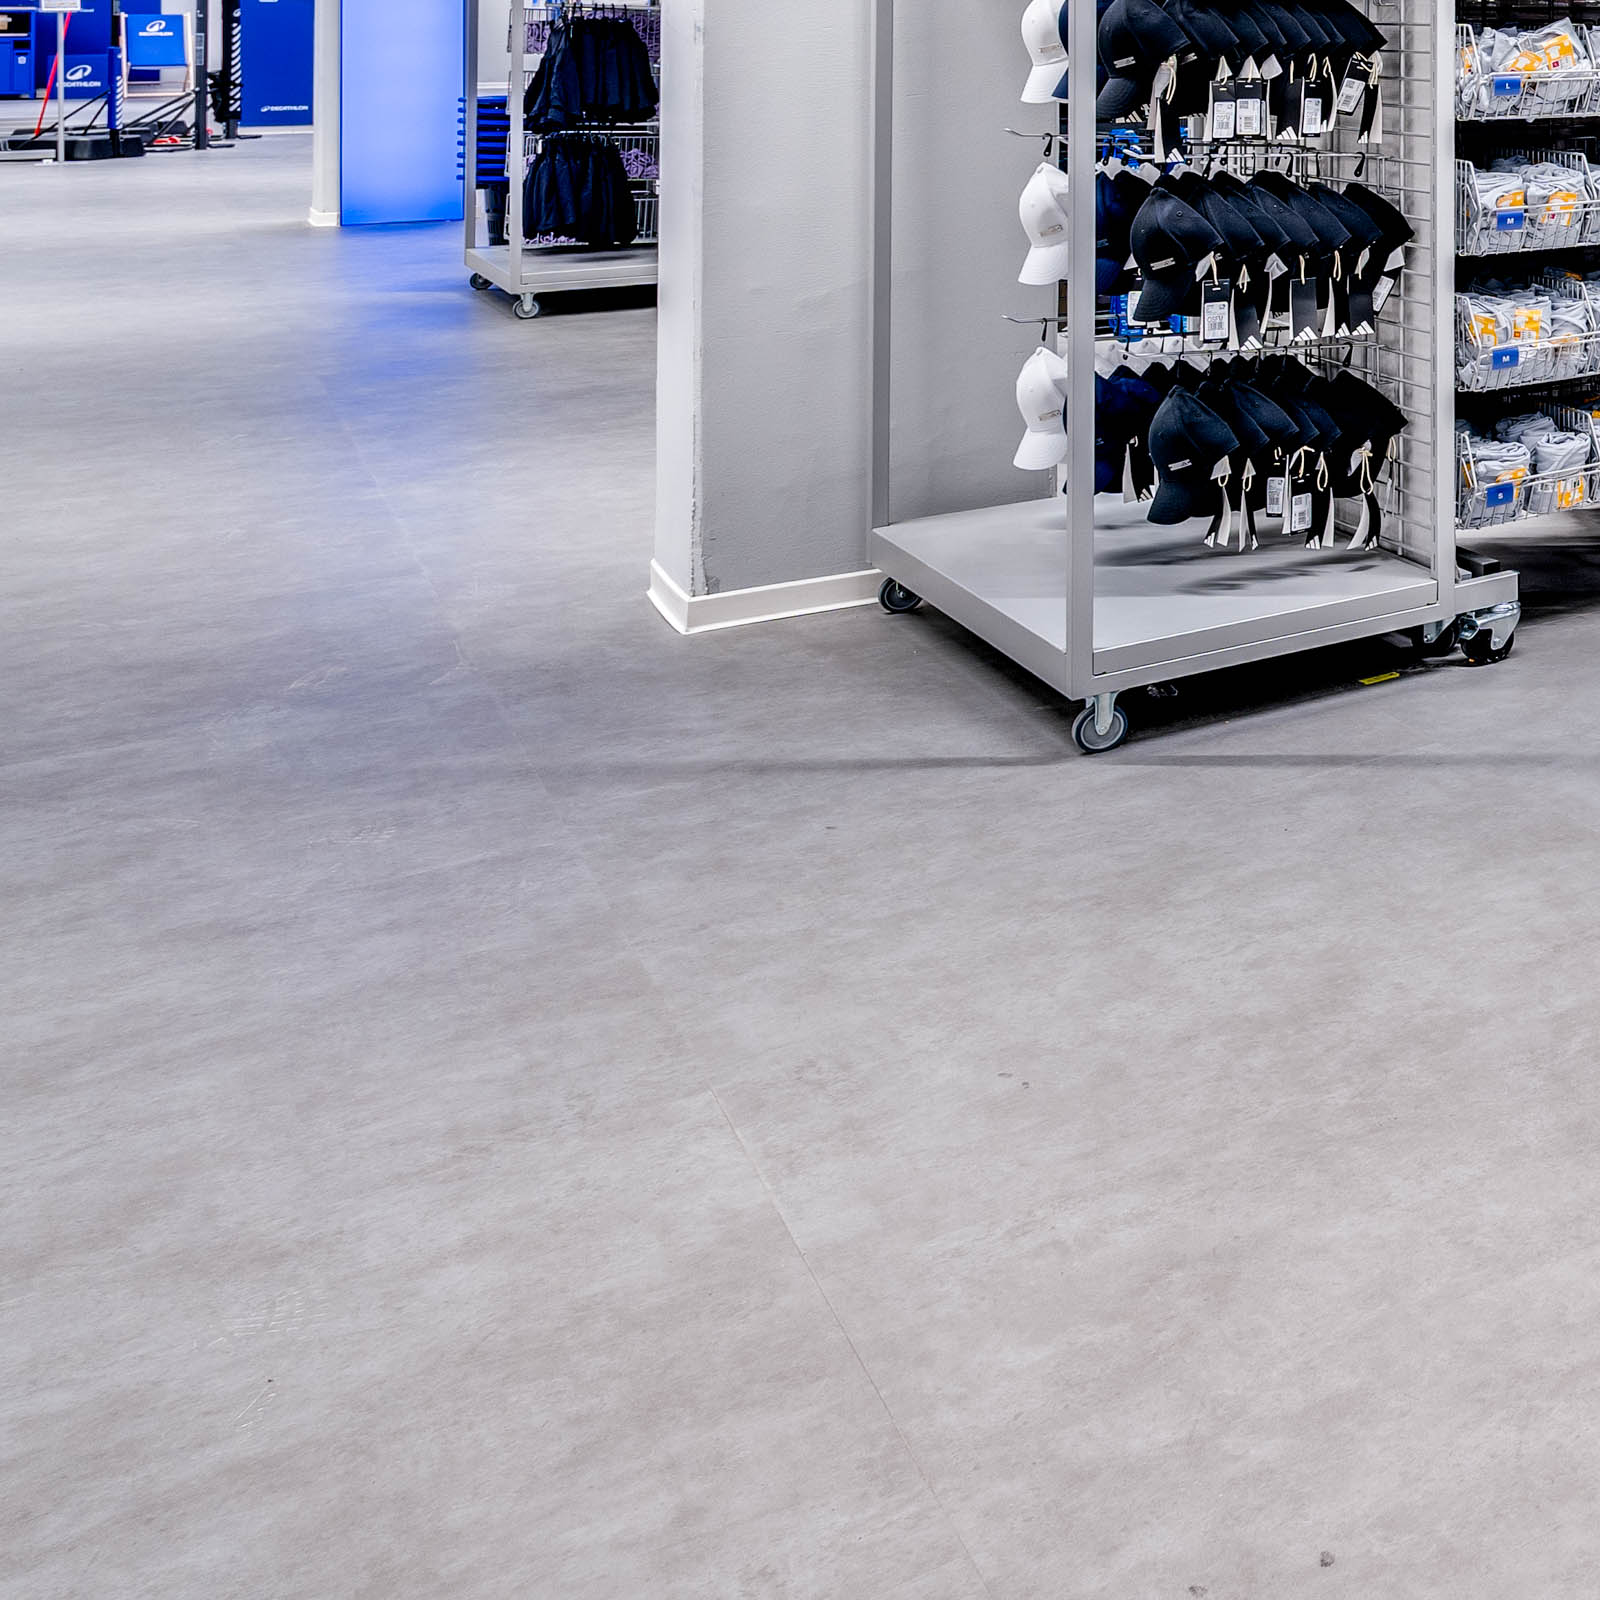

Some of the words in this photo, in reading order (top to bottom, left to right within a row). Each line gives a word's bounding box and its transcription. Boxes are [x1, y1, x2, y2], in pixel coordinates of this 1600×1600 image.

[1505, 82, 1511, 90] L
[1506, 217, 1515, 225] M
[1502, 354, 1510, 363] M
[1497, 492, 1504, 500] S
